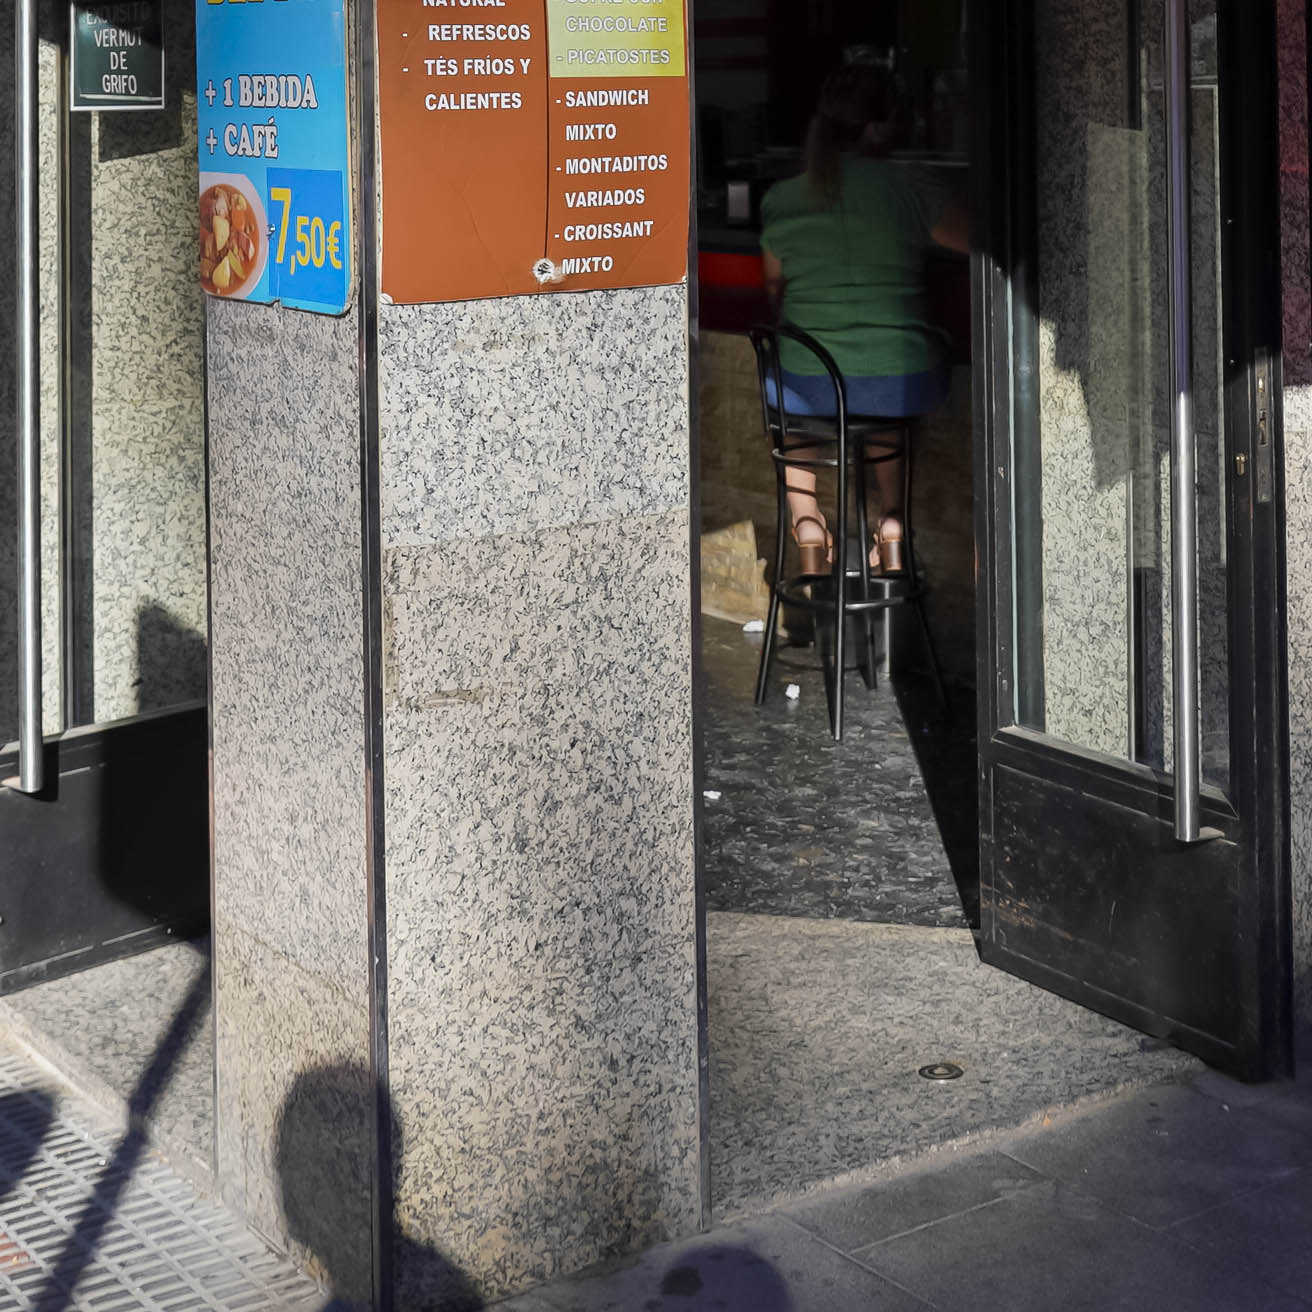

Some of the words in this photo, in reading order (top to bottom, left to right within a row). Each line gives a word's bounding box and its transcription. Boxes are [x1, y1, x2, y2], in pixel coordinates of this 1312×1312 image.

[428, 24, 531, 41] REFRESCOS
[565, 16, 668, 32] CHOCOLATE
[94, 26, 144, 48] VERMUT
[110, 51, 128, 70] DE
[464, 55, 515, 76] FRÍOS
[520, 58, 531, 75] Y
[567, 48, 671, 65] PICATOSTES
[102, 74, 138, 95] GRIFO
[223, 77, 235, 108] 1
[238, 74, 318, 110] BEBIDA
[425, 92, 522, 110] CALIENTES
[565, 89, 649, 107] SANDWICH
[223, 121, 280, 159] CAFÉ
[565, 123, 617, 141] MIXTO
[565, 154, 668, 175] MONTADITOS
[565, 188, 645, 208] VARIADOS
[270, 185, 343, 276] 7,50€
[563, 220, 653, 241] CROISSANT
[562, 255, 613, 275] MIXTO
